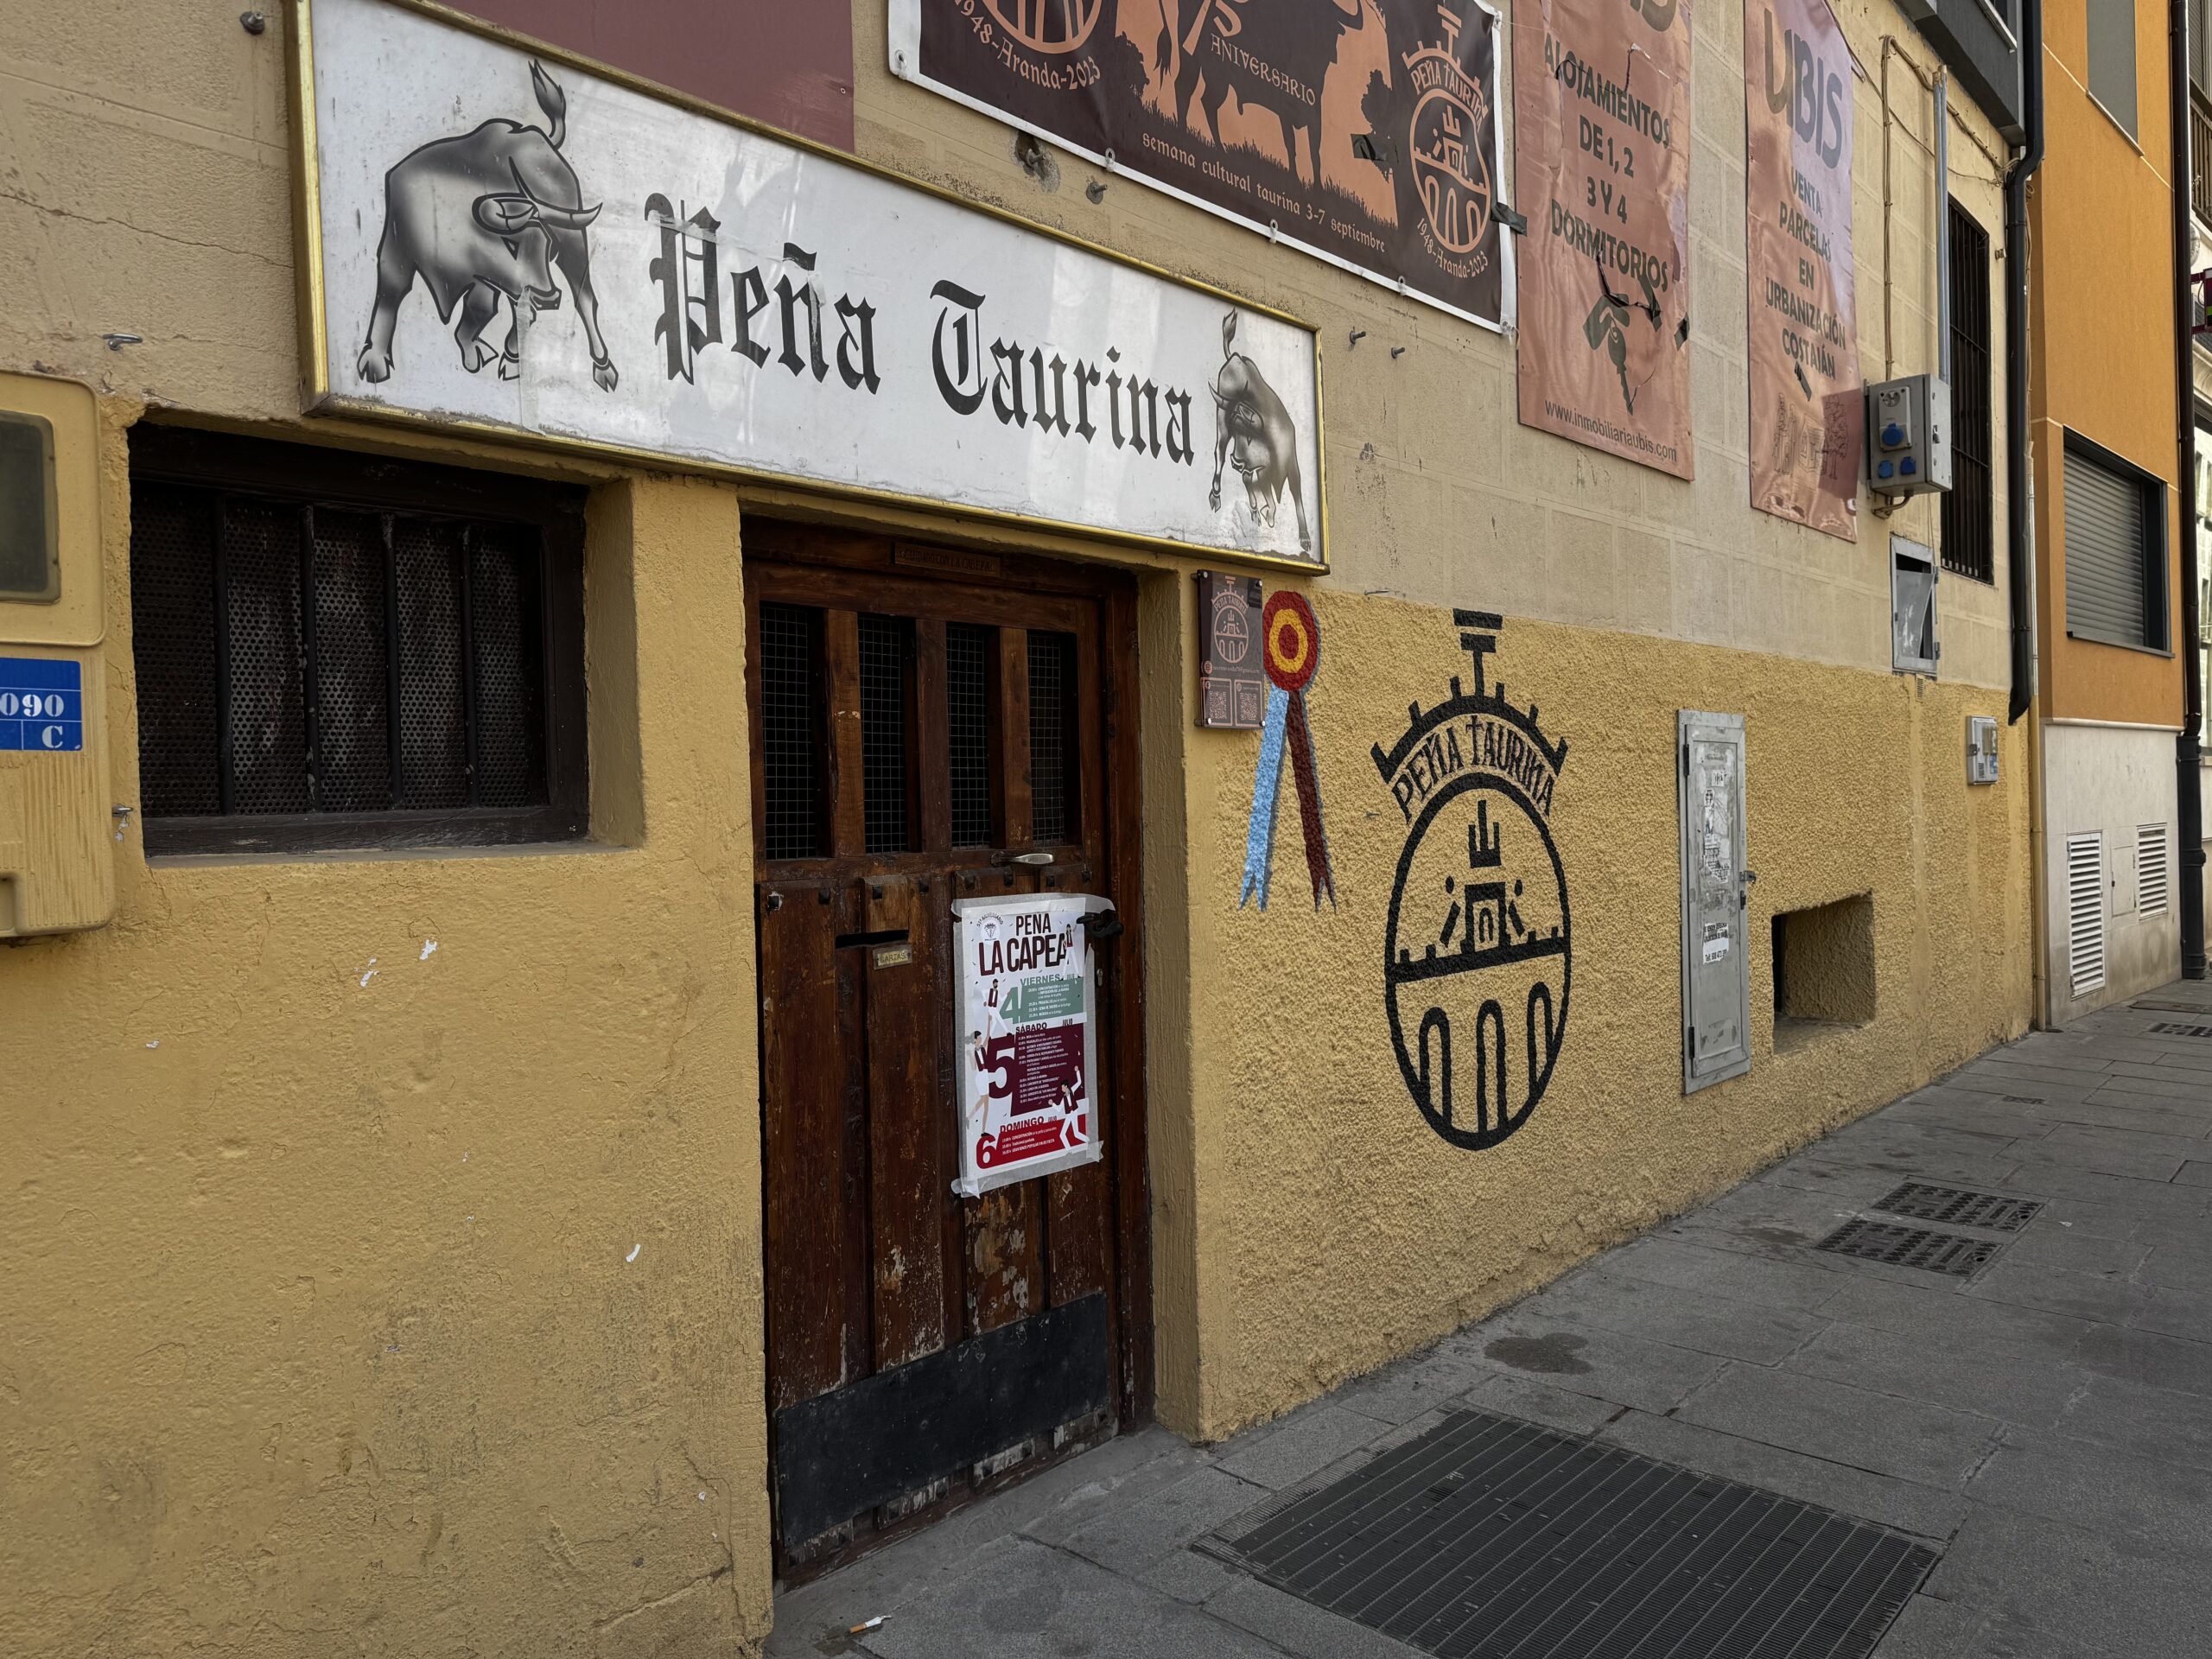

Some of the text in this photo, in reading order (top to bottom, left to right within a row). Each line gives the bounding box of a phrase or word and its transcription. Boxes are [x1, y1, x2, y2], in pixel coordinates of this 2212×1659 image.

[954, 0, 1101, 90] 948-Aranda-2023
[1211, 33, 1316, 105] ANIVERSARIO
[1545, 32, 1670, 149] ALOJAMIENTOS
[1764, 8, 1843, 169] UBIS
[1580, 114, 1604, 162] DE
[1624, 146, 1635, 179] 2
[1142, 132, 1386, 253] semana cultural taurina 3-7 septiembre
[1586, 175, 1628, 225] 3 Y 4
[1790, 166, 1823, 219] VENTA
[1417, 218, 1489, 278] 1948-Aranda-2023
[1551, 200, 1669, 293] DORMITORIOS
[1779, 200, 1831, 264] PARCELAS
[1799, 257, 1815, 291] EN
[644, 193, 1195, 467] Peña Taurina
[1765, 276, 1847, 351] URBANIZACIÓN
[1545, 400, 1677, 463] www.inmobiliariaubis.com
[41, 725, 64, 749] C
[1465, 714, 1555, 819] TAURINA
[978, 933, 1068, 976] LA CAPEA
[1020, 973, 1060, 986] VIERNES
[1000, 986, 1019, 1025] 4
[1015, 1022, 1047, 1033] SÁBADO
[987, 1035, 1015, 1099] 5
[976, 1133, 997, 1169] 6
[1000, 1116, 1045, 1133] DOMINGO
